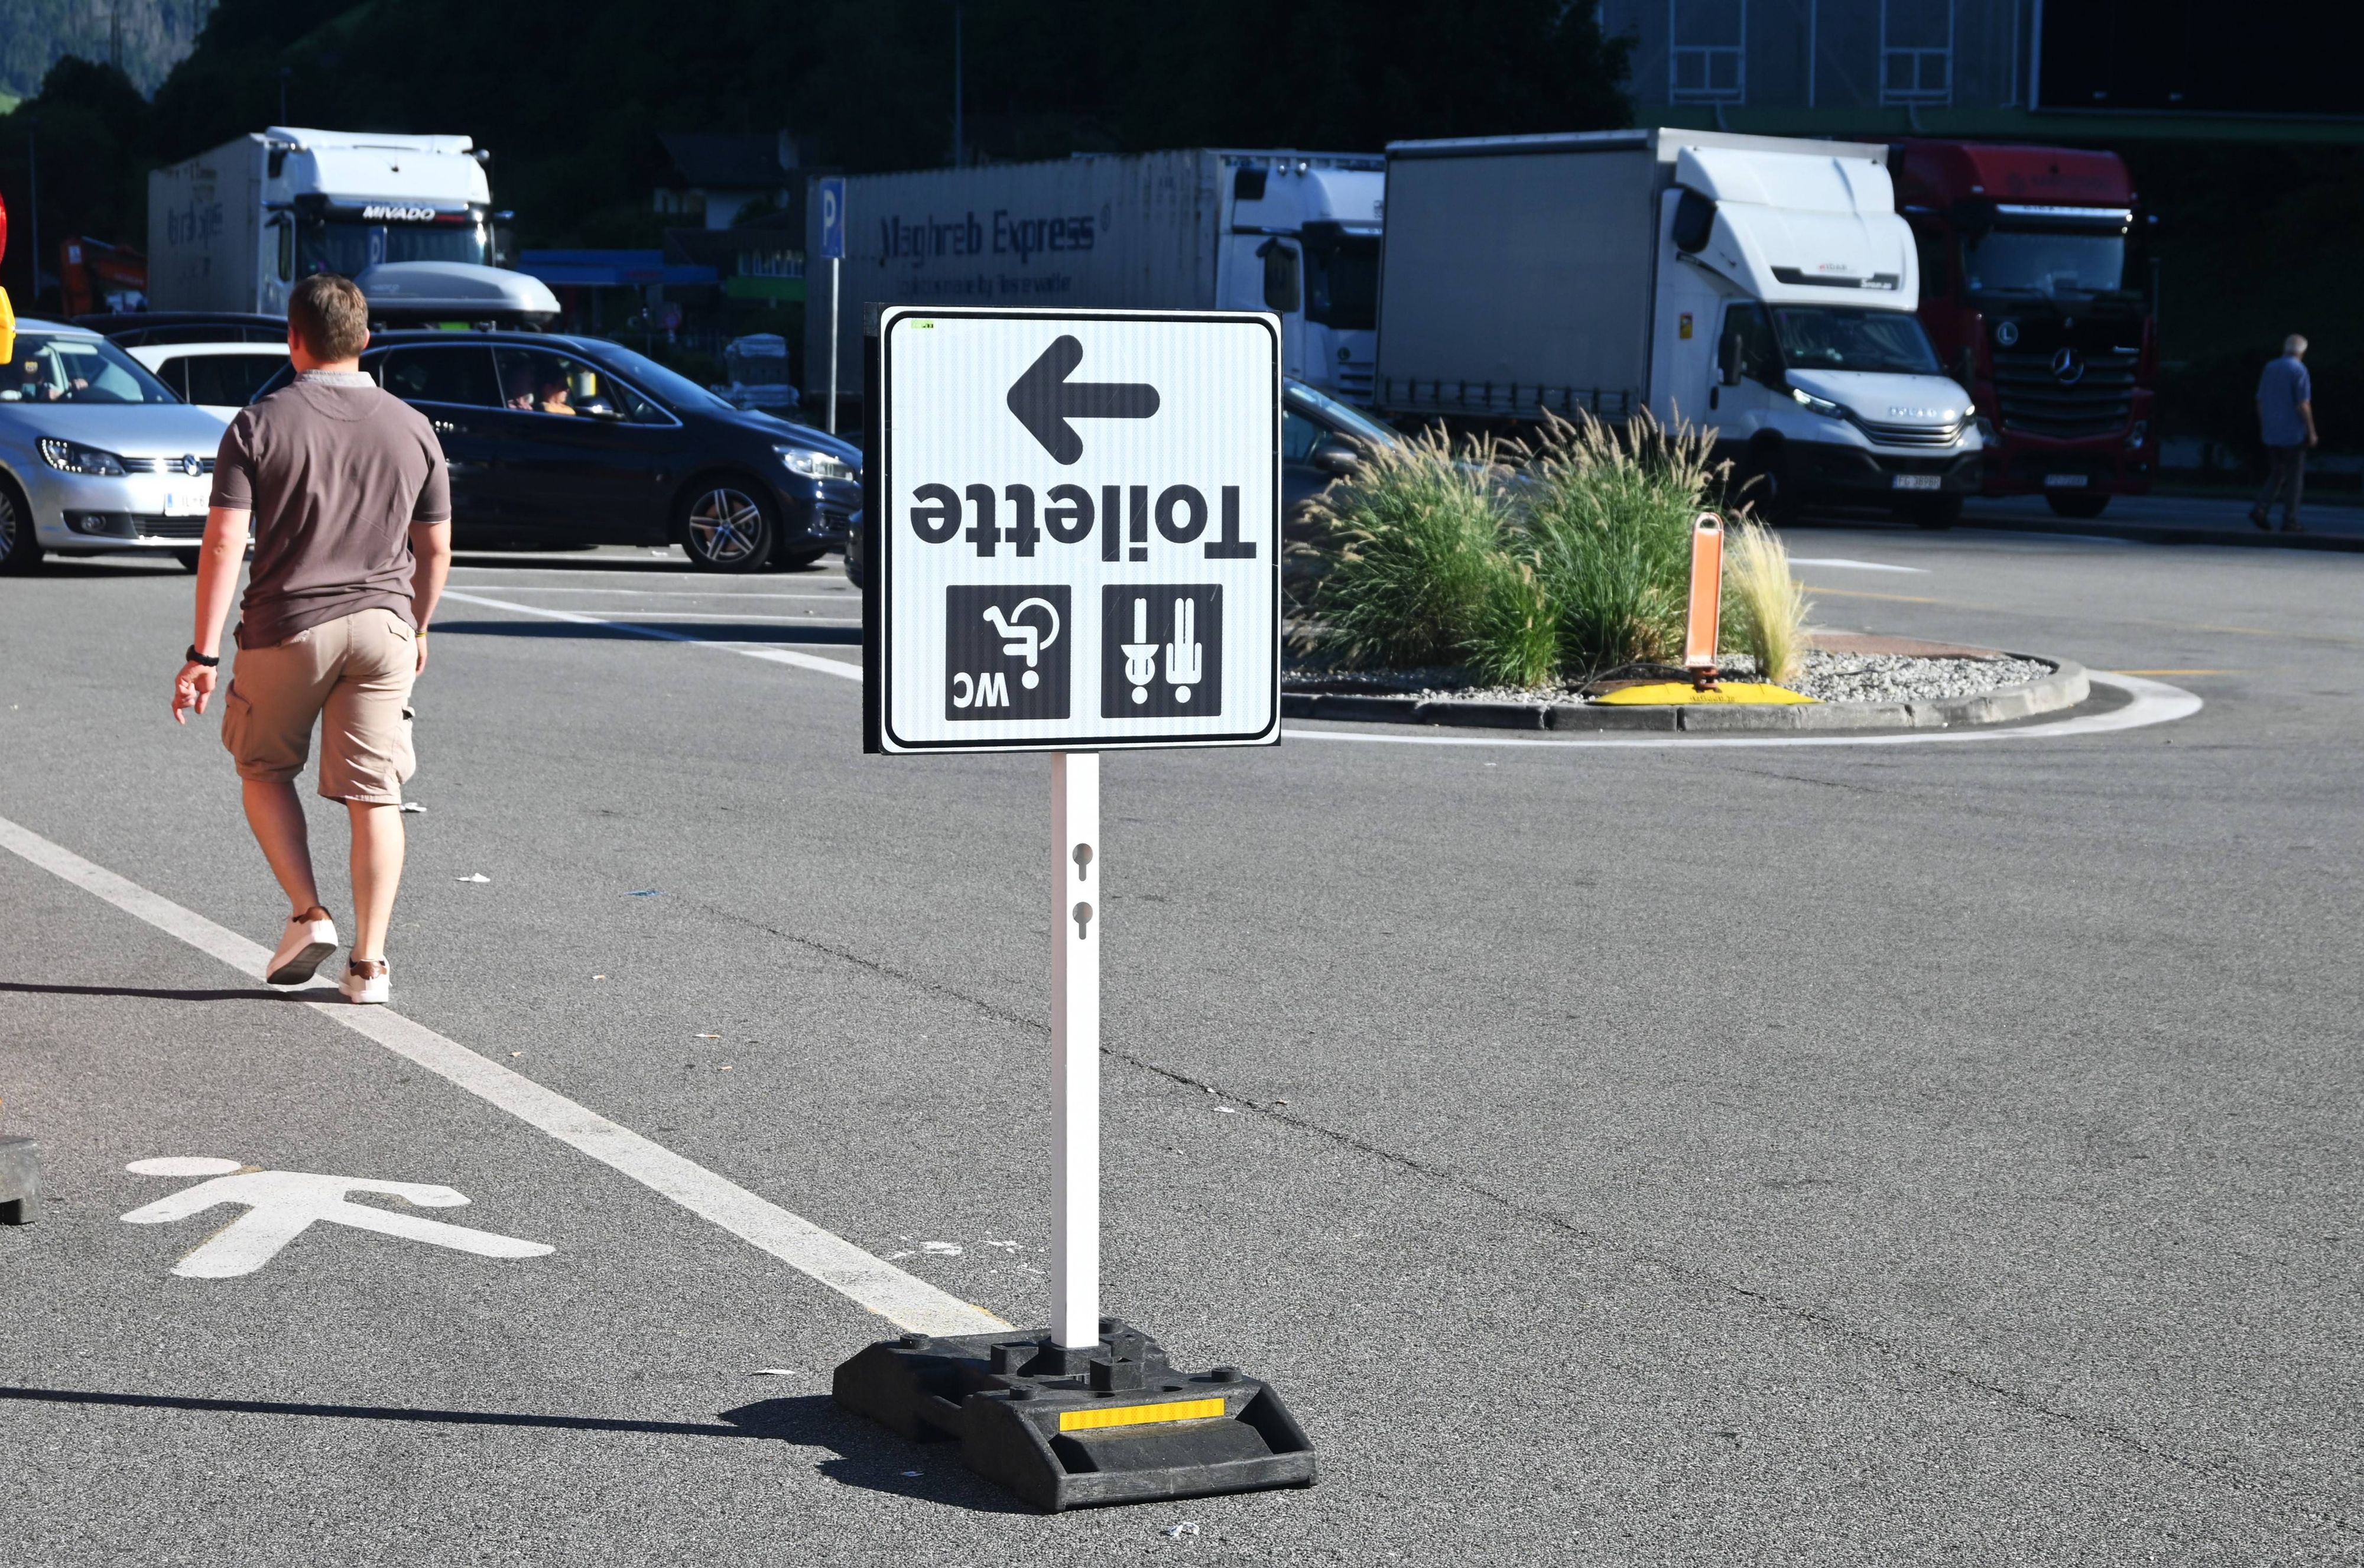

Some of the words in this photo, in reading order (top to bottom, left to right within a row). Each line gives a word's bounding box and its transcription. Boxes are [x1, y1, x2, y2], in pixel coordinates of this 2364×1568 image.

[362, 205, 436, 222] MIVADO
[823, 189, 836, 246] P
[881, 211, 982, 268] Maghreb
[993, 209, 1095, 265] Express
[910, 483, 1256, 561] Toilette
[953, 672, 1009, 707] WC
